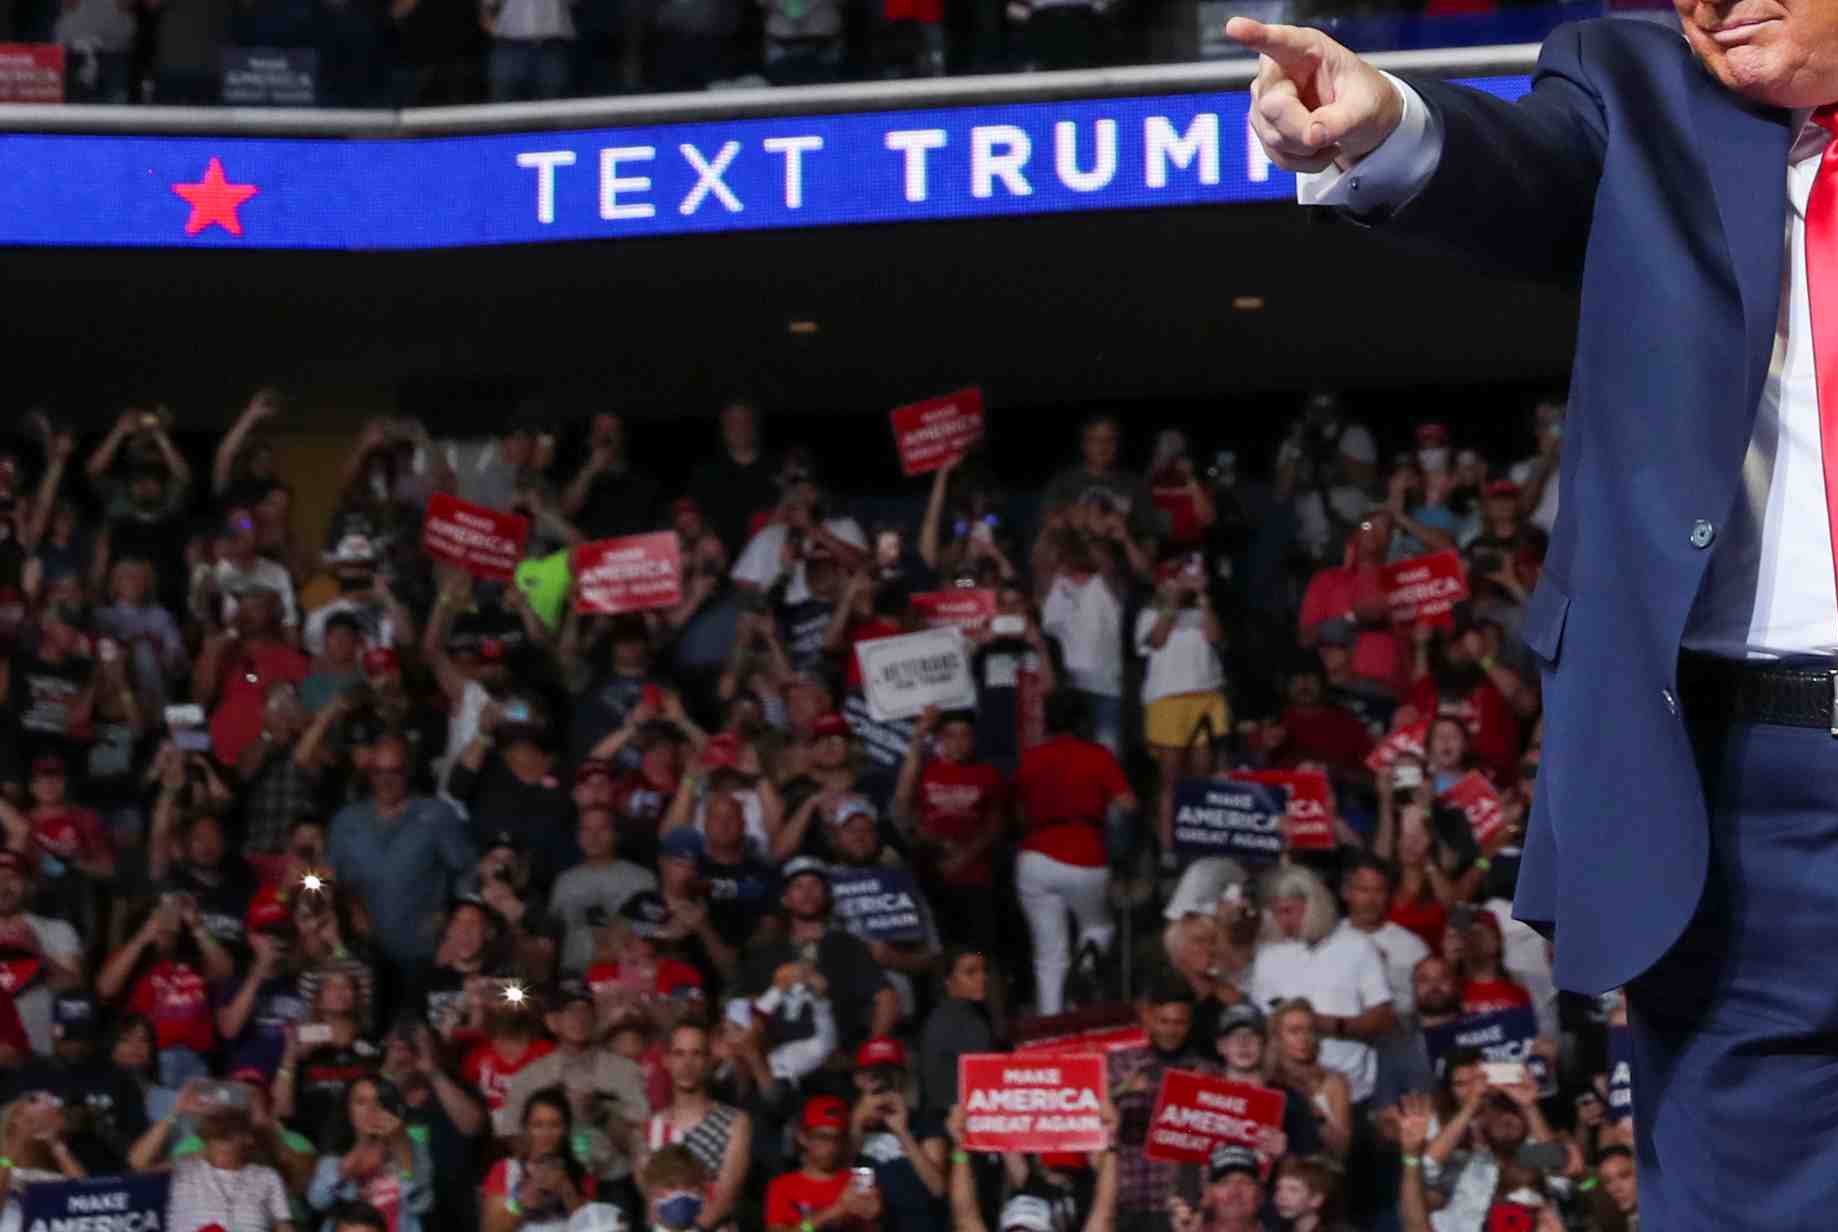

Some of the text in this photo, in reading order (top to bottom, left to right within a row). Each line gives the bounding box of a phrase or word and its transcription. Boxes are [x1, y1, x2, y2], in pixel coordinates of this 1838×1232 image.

[516, 135, 823, 224] TEXT
[1205, 789, 1253, 809] MAKE
[1176, 825, 1228, 845] GREAT
[1455, 1024, 1504, 1048] MAKE
[1002, 1067, 1061, 1086] MAKE
[966, 1088, 1101, 1113] AMERICA
[1196, 1089, 1248, 1114] MAKE
[966, 1113, 1102, 1134] GREAT AGAIN
[1159, 1103, 1258, 1143] AMERIC
[1151, 1127, 1213, 1153] GREAT
[66, 1191, 131, 1215] MAKE
[28, 1210, 162, 1232] AMERICA
